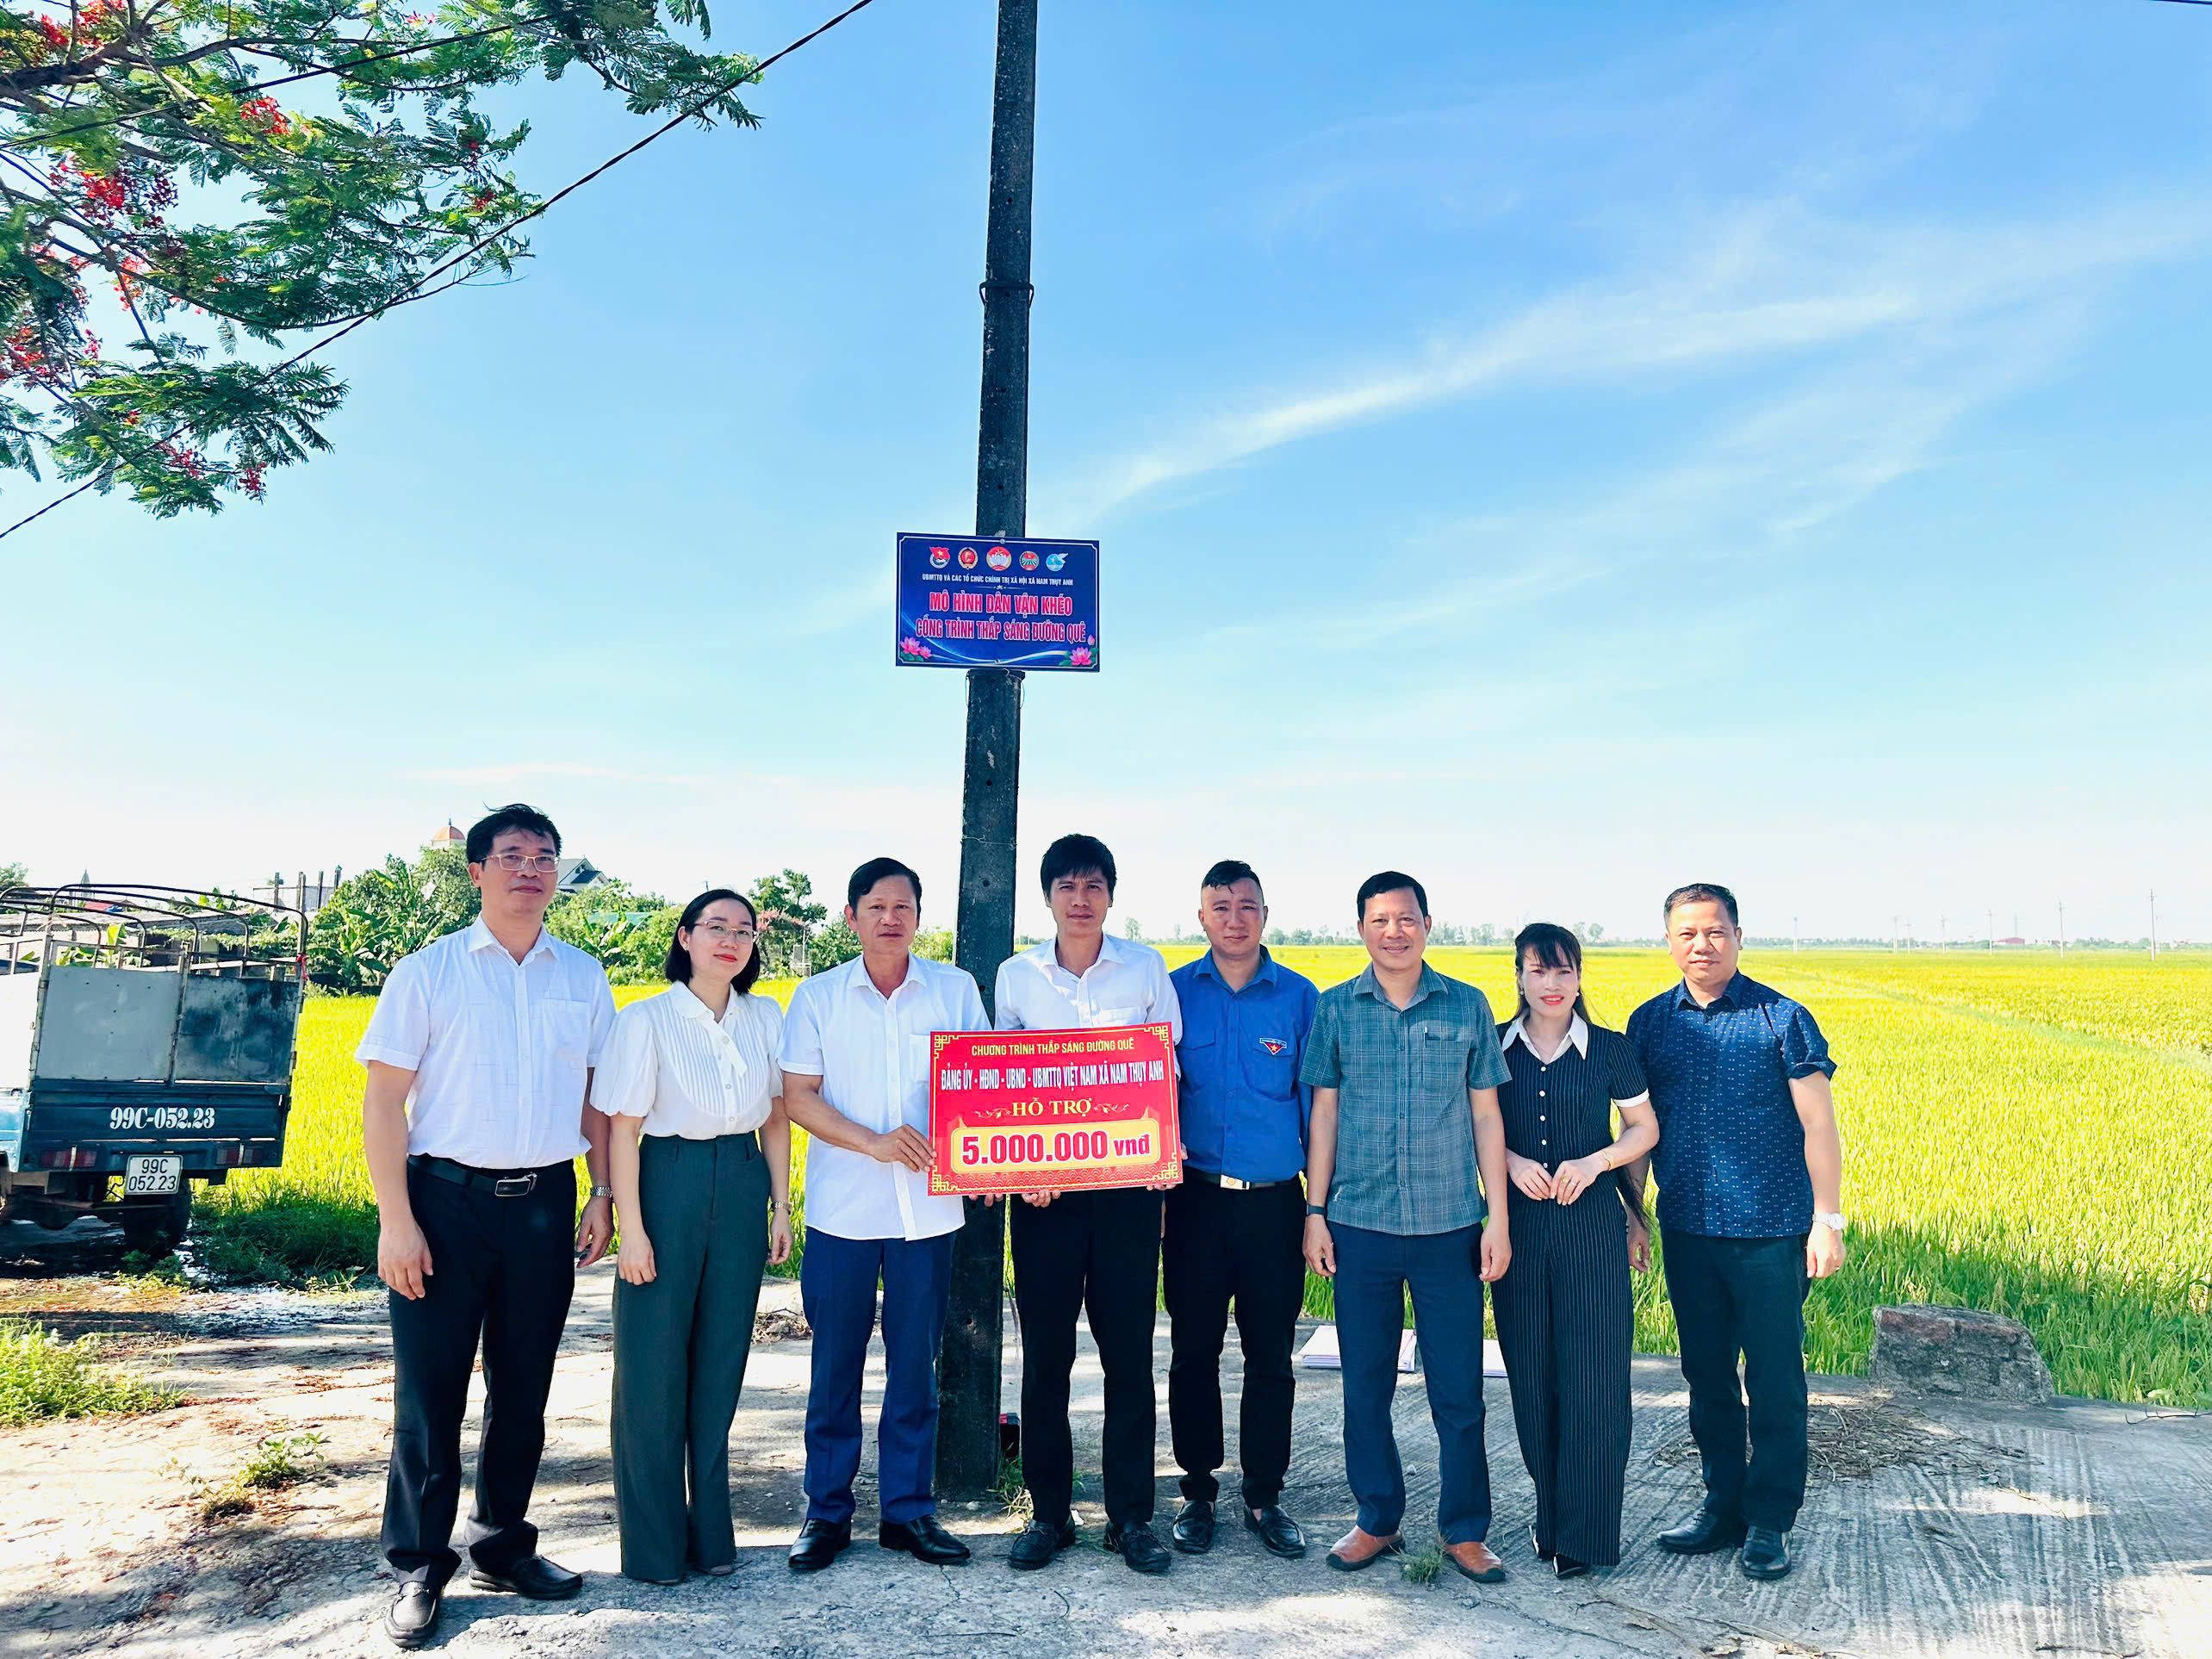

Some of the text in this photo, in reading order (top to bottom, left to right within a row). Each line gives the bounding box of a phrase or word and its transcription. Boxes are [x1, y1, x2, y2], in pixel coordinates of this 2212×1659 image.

[923, 573, 942, 581] UBMTTQ
[985, 575, 1001, 583] CHÍNH
[1010, 575, 1018, 584] XÃ
[929, 589, 1072, 618] MÔ HÌNH DÂN VẬN KHÉO
[945, 617, 975, 639] TRÌNH
[976, 615, 1002, 640] THẮP
[1003, 618, 1030, 641] SÁNG
[1066, 620, 1086, 644] QUÊ
[1009, 1042, 1035, 1055] TRÌNH
[1037, 1039, 1059, 1054] THẮP
[1061, 1040, 1085, 1053] SÁNG
[1117, 1036, 1134, 1050] QUÊ
[941, 1062, 961, 1090] ĐẢNG
[963, 1062, 973, 1090] ỦY
[979, 1068, 999, 1090] HĐND
[1006, 1067, 1027, 1090] UBND
[1032, 1066, 1061, 1089] UBMTTQ
[1063, 1061, 1078, 1091] VIỆT
[1079, 1064, 1097, 1086] NAM
[1098, 1059, 1109, 1085] XÃ
[1109, 1062, 1128, 1084] NAM
[1128, 1060, 1146, 1087] THỤY
[1148, 1059, 1165, 1081] ANH
[1012, 1097, 1092, 1117] HỖ TRỢ
[109, 1107, 215, 1129] 99C-052.23
[962, 1130, 1151, 1165] 5.000.000 vnđ
[141, 1159, 168, 1174] 99C
[128, 1176, 176, 1190] 052.23
